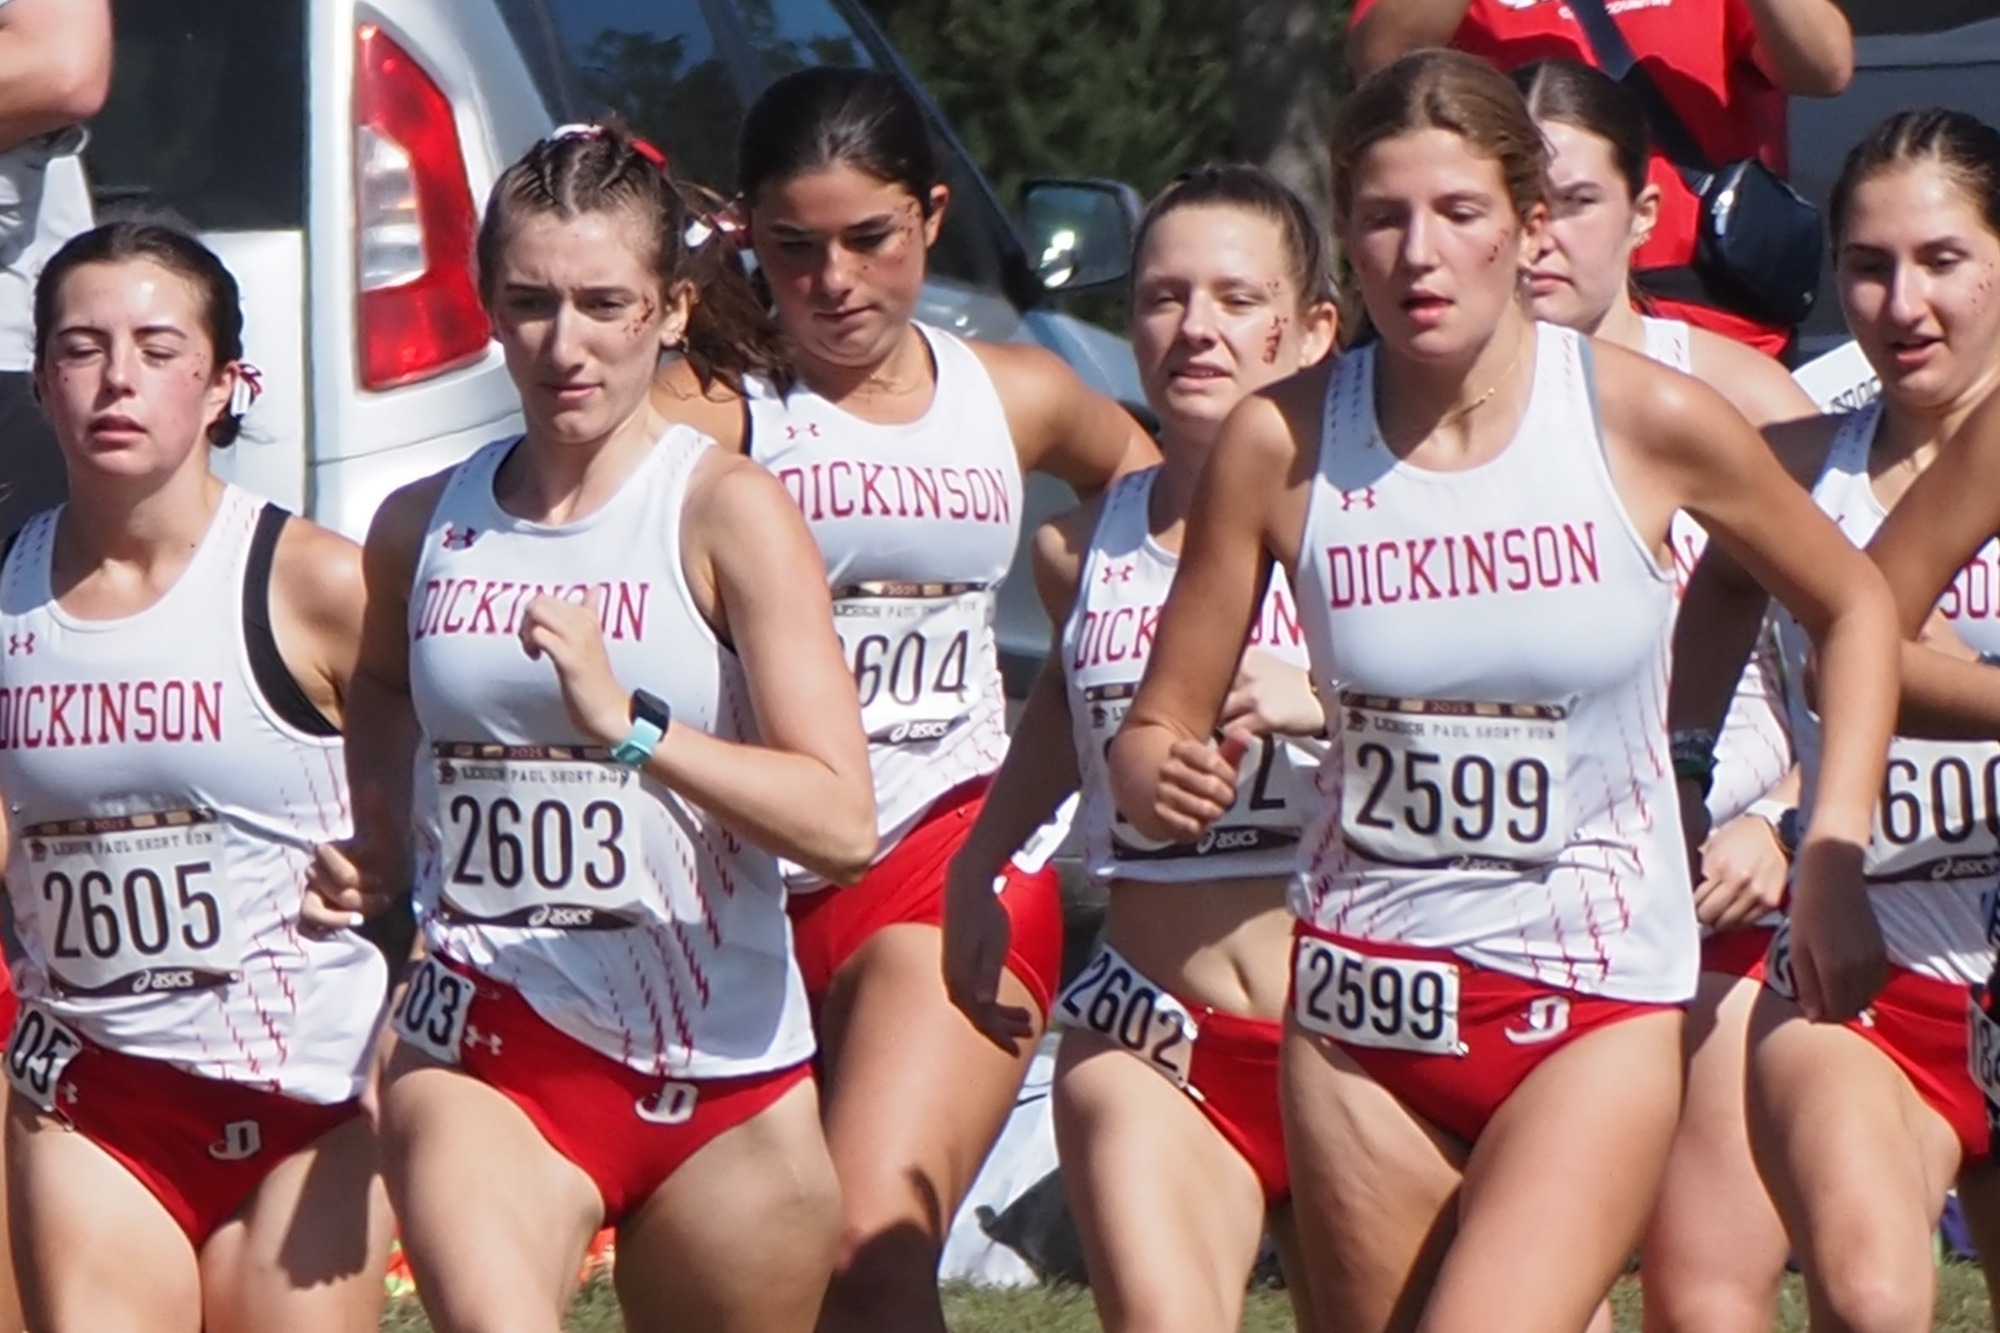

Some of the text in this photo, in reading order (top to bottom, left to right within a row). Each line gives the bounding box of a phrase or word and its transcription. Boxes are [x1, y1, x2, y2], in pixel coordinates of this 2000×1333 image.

[779, 461, 1010, 524] DICKINSON
[1326, 521, 1599, 609] DICKINSON
[414, 578, 649, 642] DICKION
[1074, 590, 1303, 671] DICKN
[839, 629, 970, 709] 604
[0, 681, 223, 750] DICKINSON
[1432, 723, 1470, 739] PAUL
[1476, 726, 1520, 740] SHORT
[1527, 727, 1556, 740] RUN
[510, 769, 545, 783] PAUL
[550, 771, 592, 783] SHORT
[1355, 742, 1550, 844] 2599
[99, 839, 130, 854] PAUL
[136, 835, 179, 852] SHORT
[451, 795, 626, 890] 2603
[1216, 830, 1258, 849] asics
[43, 861, 221, 959] 2605
[152, 971, 194, 988] asics
[394, 961, 461, 1047] 03
[1062, 952, 1185, 1072] 2602
[1306, 947, 1445, 1040] 2599
[9, 1009, 73, 1095] 05
